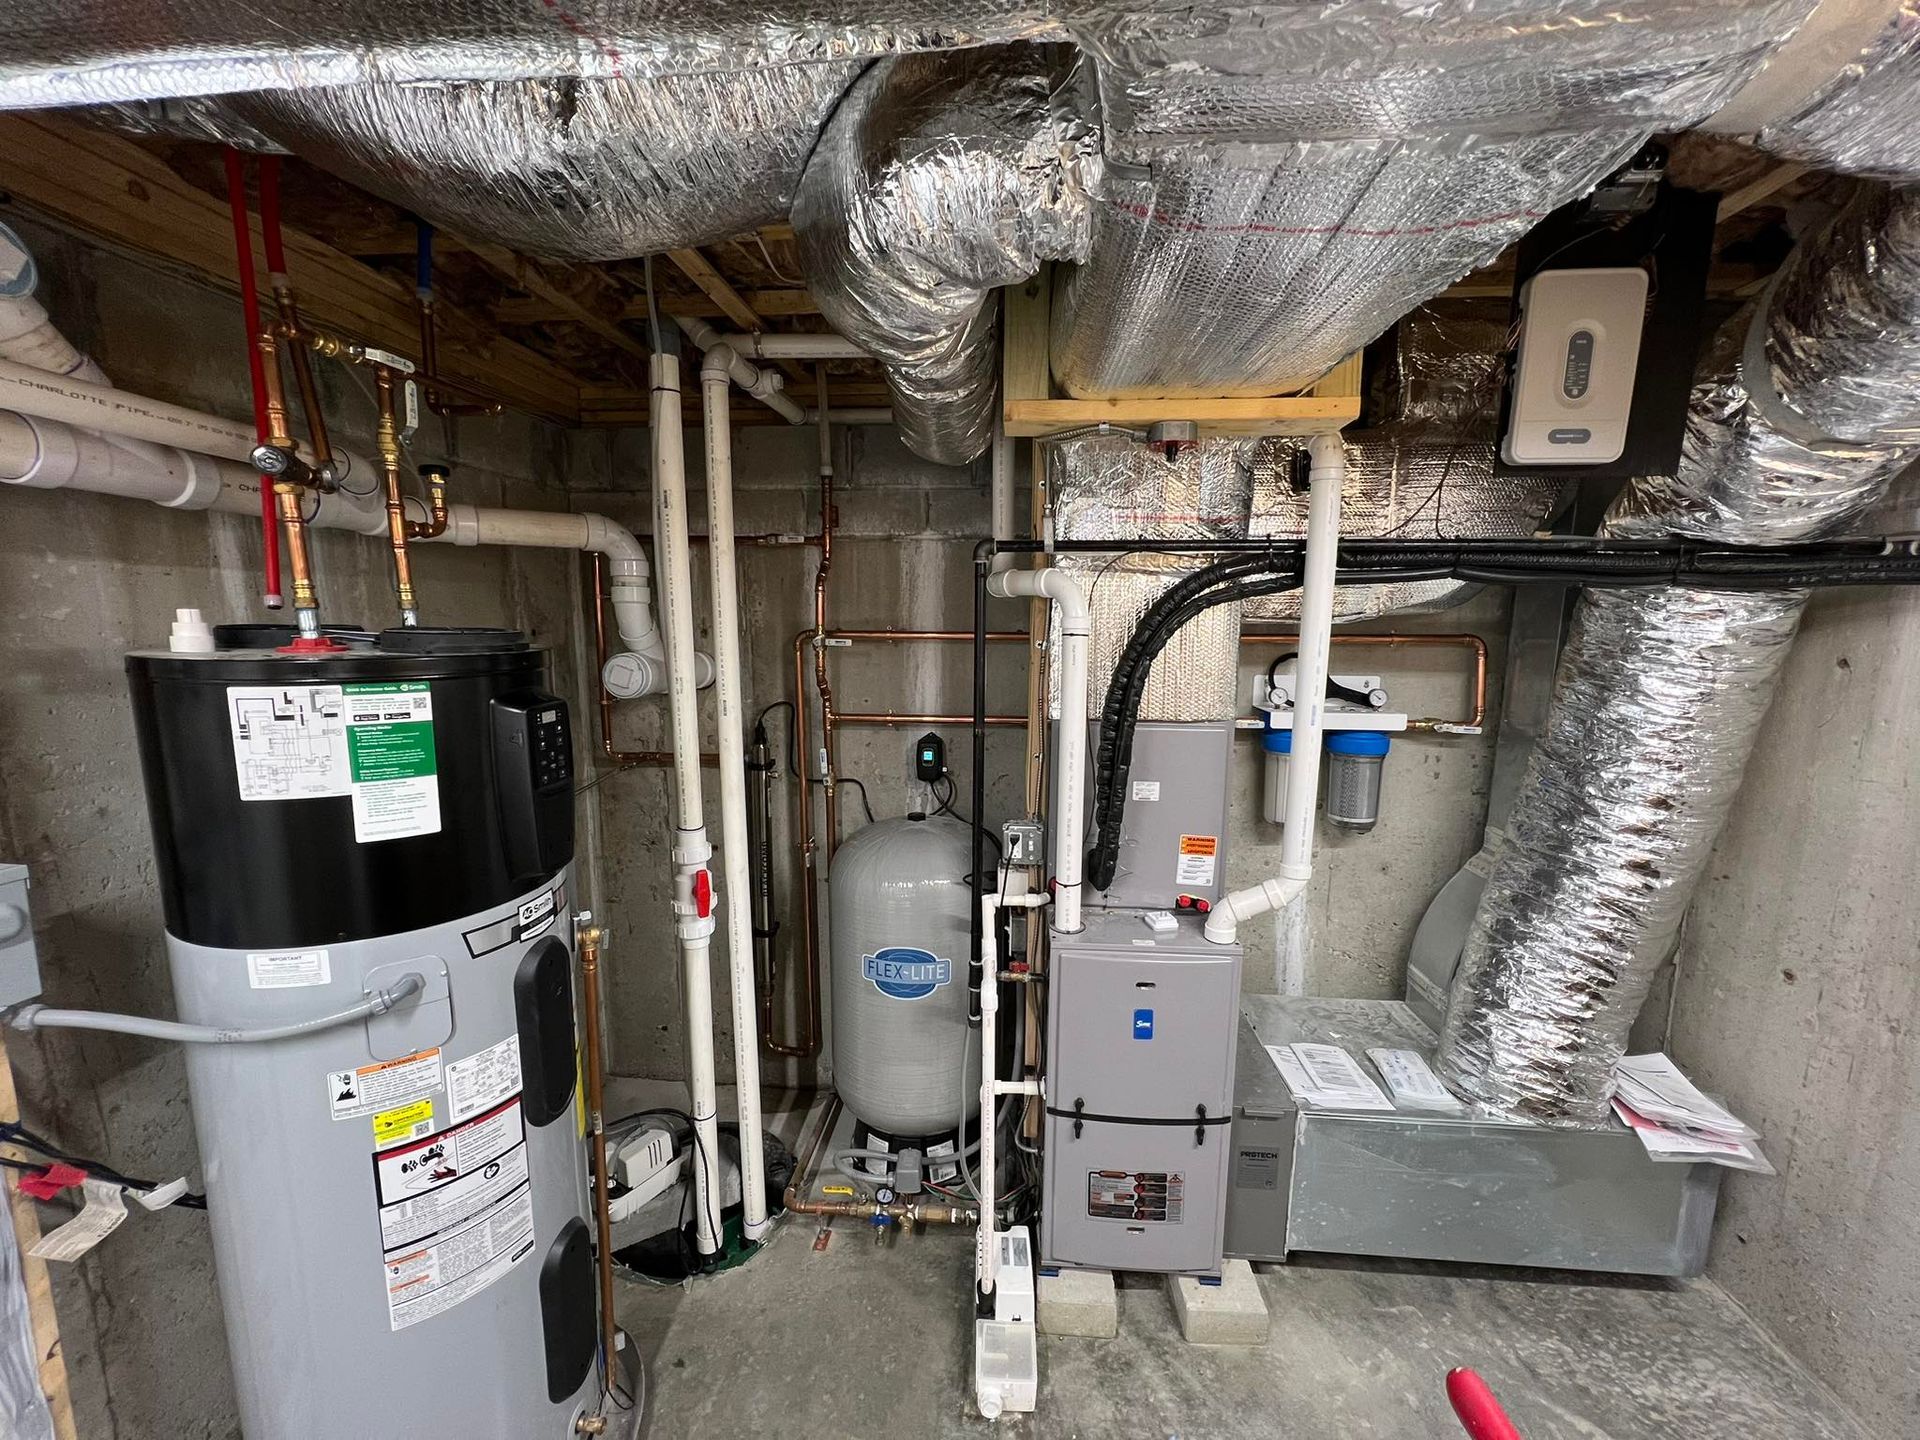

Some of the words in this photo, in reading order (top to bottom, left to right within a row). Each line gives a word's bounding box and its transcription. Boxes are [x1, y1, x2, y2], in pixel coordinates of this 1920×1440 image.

[18, 378, 108, 407] CHARLOTTE
[868, 960, 945, 981] FLEX-LITE
[446, 1122, 475, 1138] DANGER
